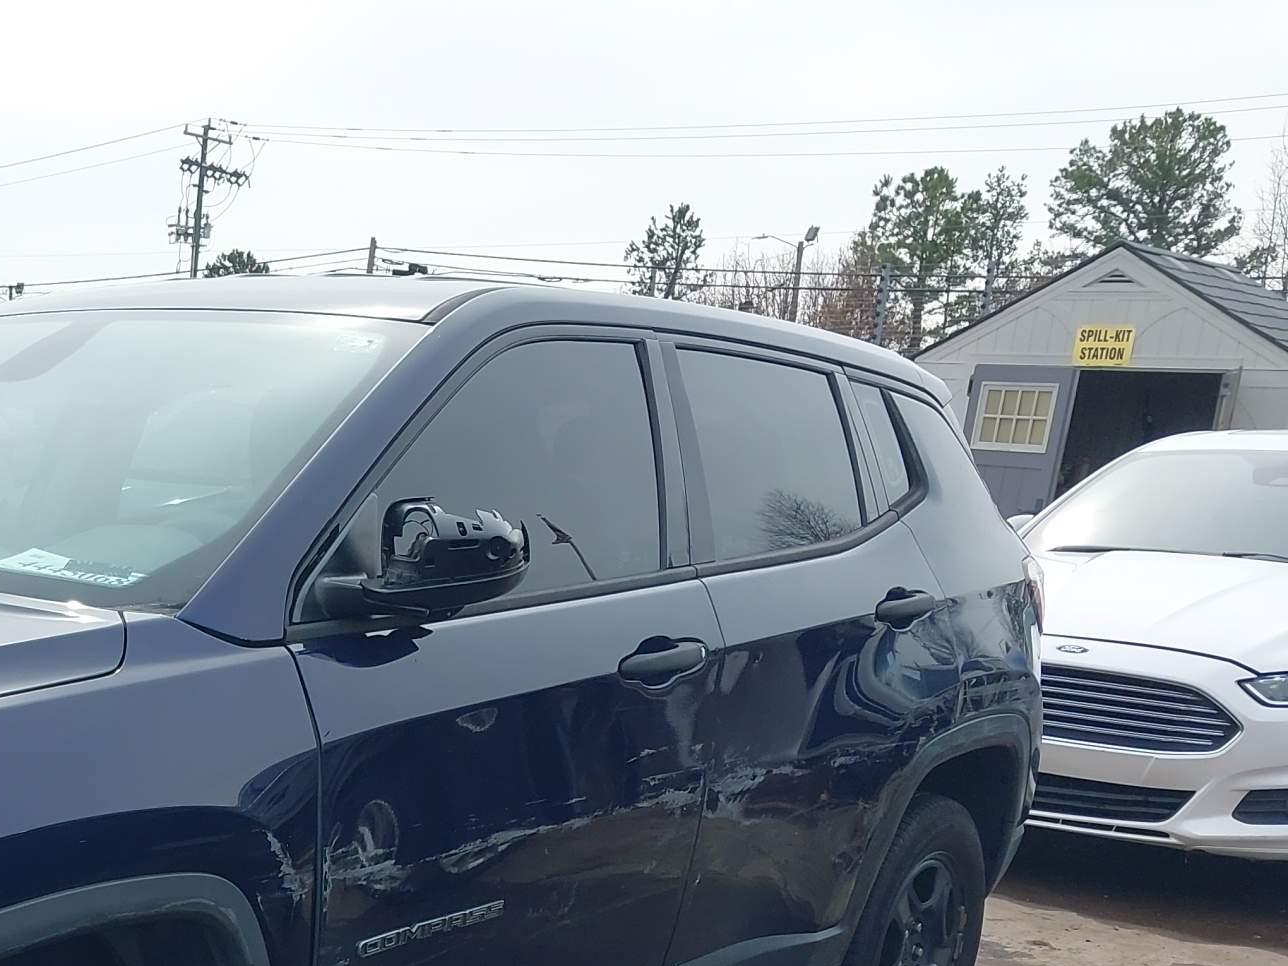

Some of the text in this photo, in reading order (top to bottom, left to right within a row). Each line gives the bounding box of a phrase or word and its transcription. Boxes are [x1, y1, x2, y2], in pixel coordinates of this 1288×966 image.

[1079, 329, 1133, 342] SPILL-KIT
[1079, 347, 1125, 361] STATION
[356, 899, 505, 958] COMPASS
